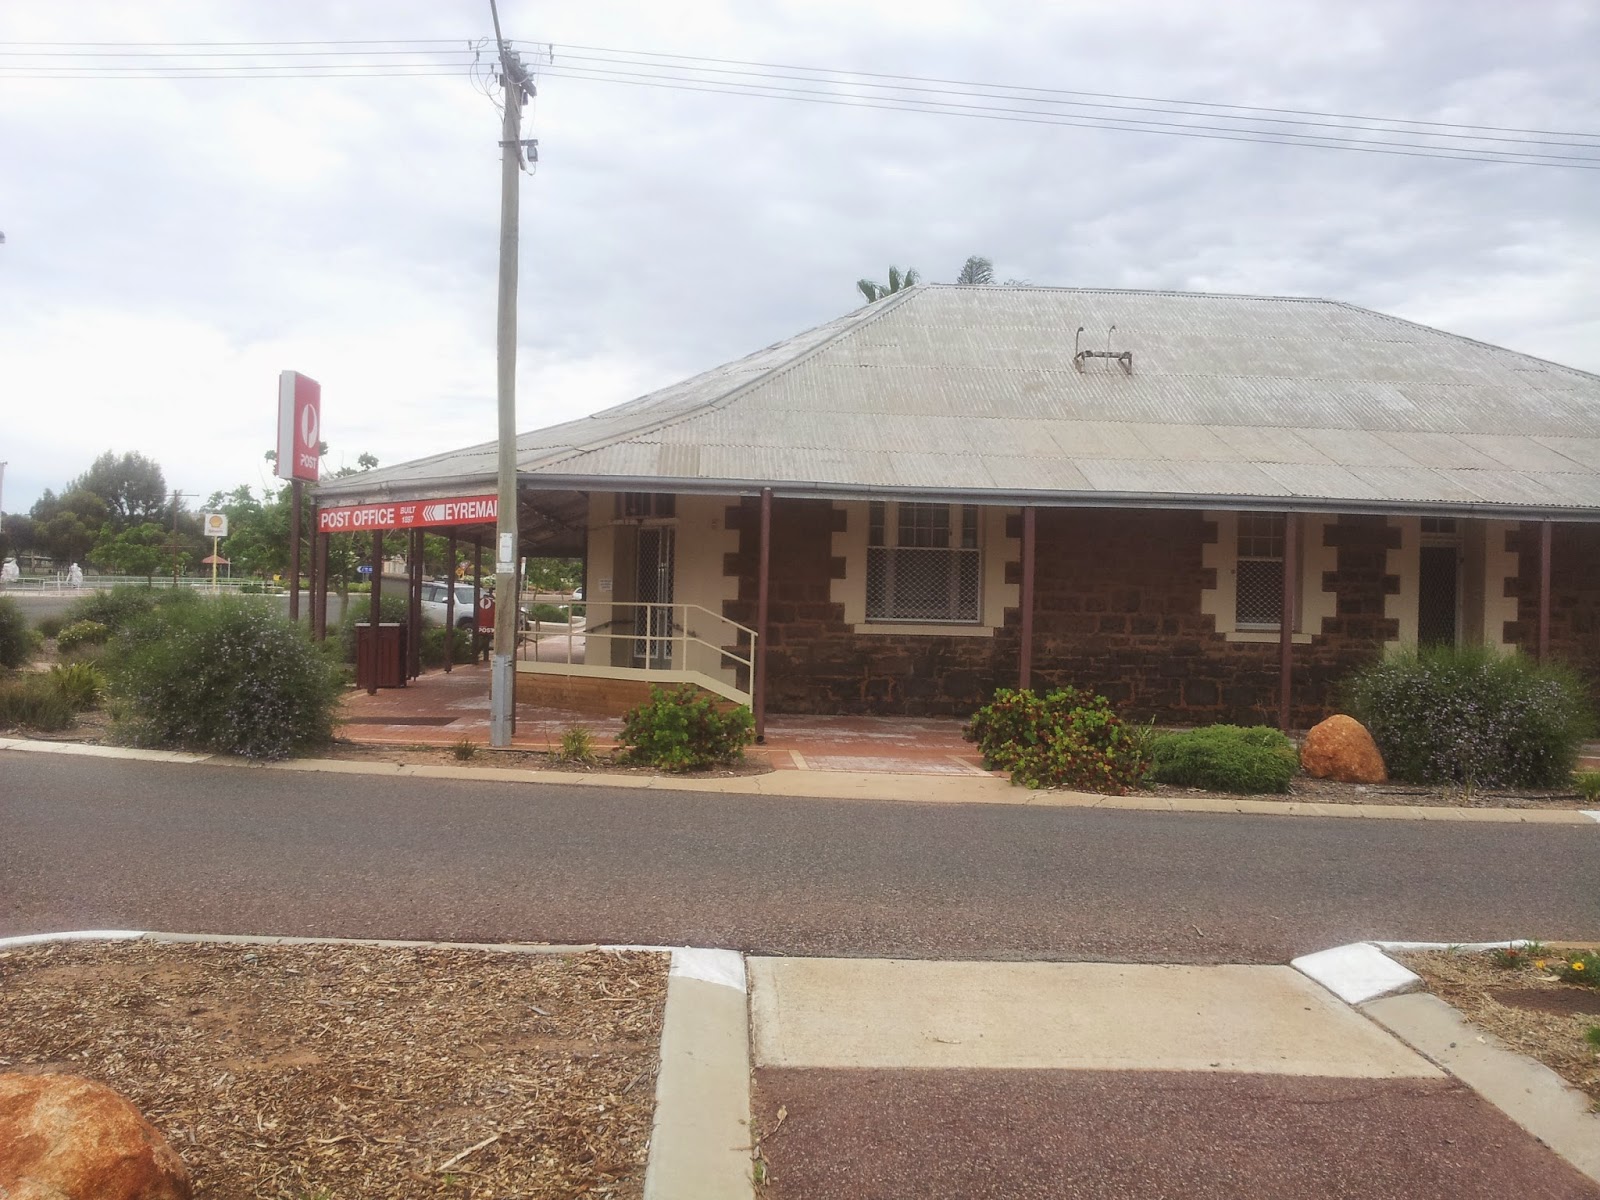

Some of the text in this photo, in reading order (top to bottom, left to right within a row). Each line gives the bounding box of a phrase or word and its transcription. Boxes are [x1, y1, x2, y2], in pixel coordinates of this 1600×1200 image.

[300, 453, 317, 469] POST
[321, 508, 395, 528] POST OFFICE
[400, 506, 416, 515] BUILT
